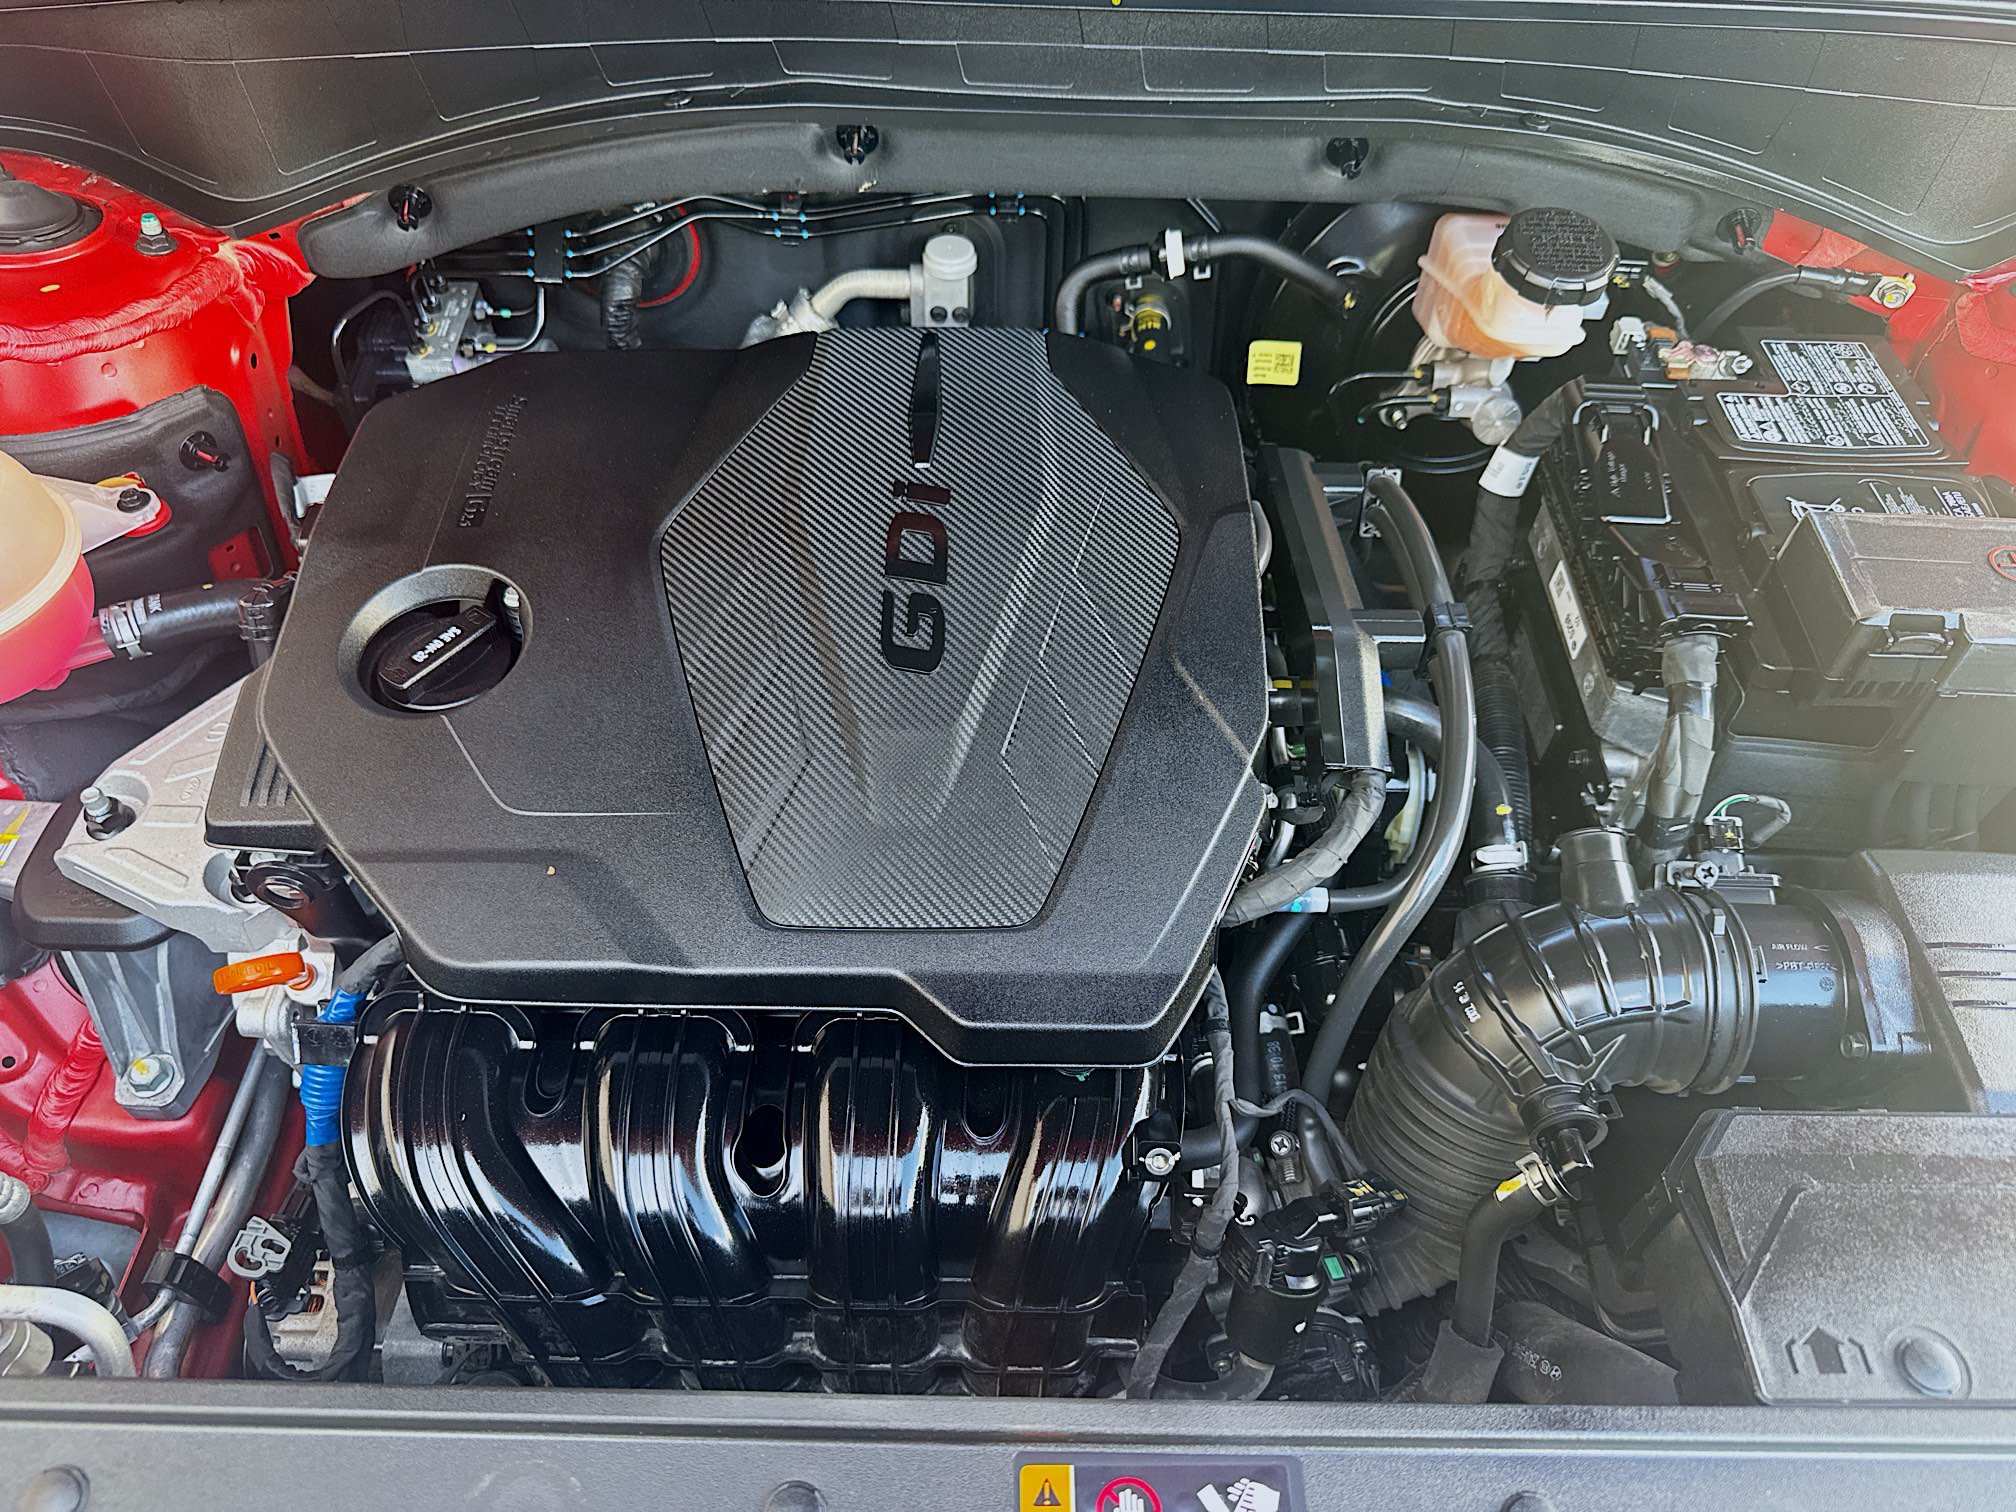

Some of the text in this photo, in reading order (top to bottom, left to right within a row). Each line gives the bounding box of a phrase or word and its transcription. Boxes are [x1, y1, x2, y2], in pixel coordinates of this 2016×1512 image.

[480, 394, 528, 493] Smartstream
[411, 626, 462, 663] SAE 0W-20
[1771, 943, 1785, 951] AIR
[255, 963, 275, 973] OIL
